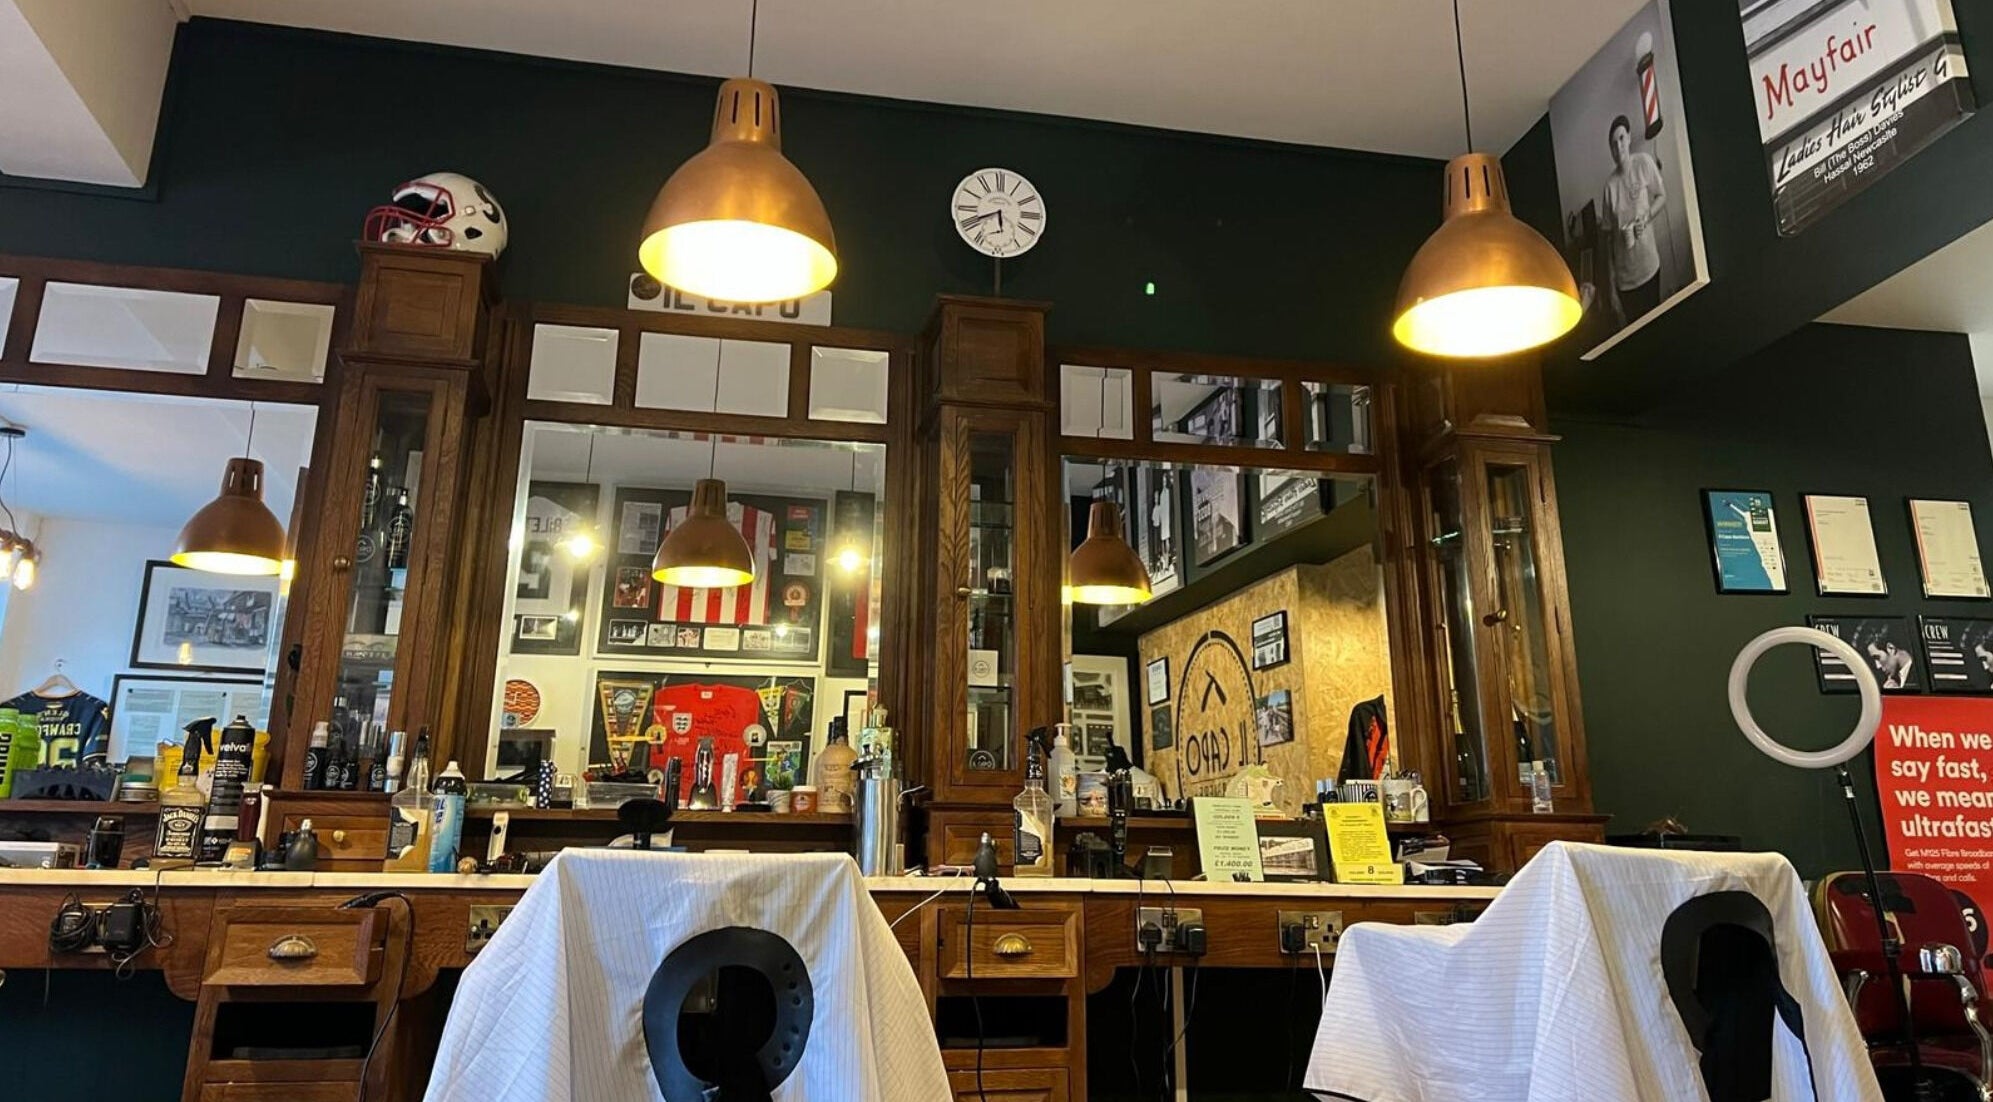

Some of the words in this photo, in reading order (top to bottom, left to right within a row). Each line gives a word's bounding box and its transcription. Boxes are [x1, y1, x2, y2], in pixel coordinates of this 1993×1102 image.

[1762, 22, 1876, 120] Mayfair
[1777, 135, 1822, 183] Ladies
[1826, 108, 1867, 147] Hair
[1871, 68, 1928, 117] Stylist
[1827, 150, 1847, 173] (The
[1848, 131, 1872, 154] Boss)
[1874, 111, 1904, 136] Davies
[1852, 156, 1875, 176] 1962
[1925, 625, 1949, 640] CREW
[1889, 724, 1955, 749] When
[1960, 733, 1993, 750] we
[1891, 759, 1931, 783] say
[1936, 755, 1987, 783] fast,
[1894, 790, 1931, 807] we
[1905, 848, 1920, 857] Get
[1907, 861, 1923, 869] with
[1924, 863, 1955, 871] average
[1955, 862, 1981, 871] speeds
[1982, 860, 1990, 869] of
[1942, 874, 1957, 882] and
